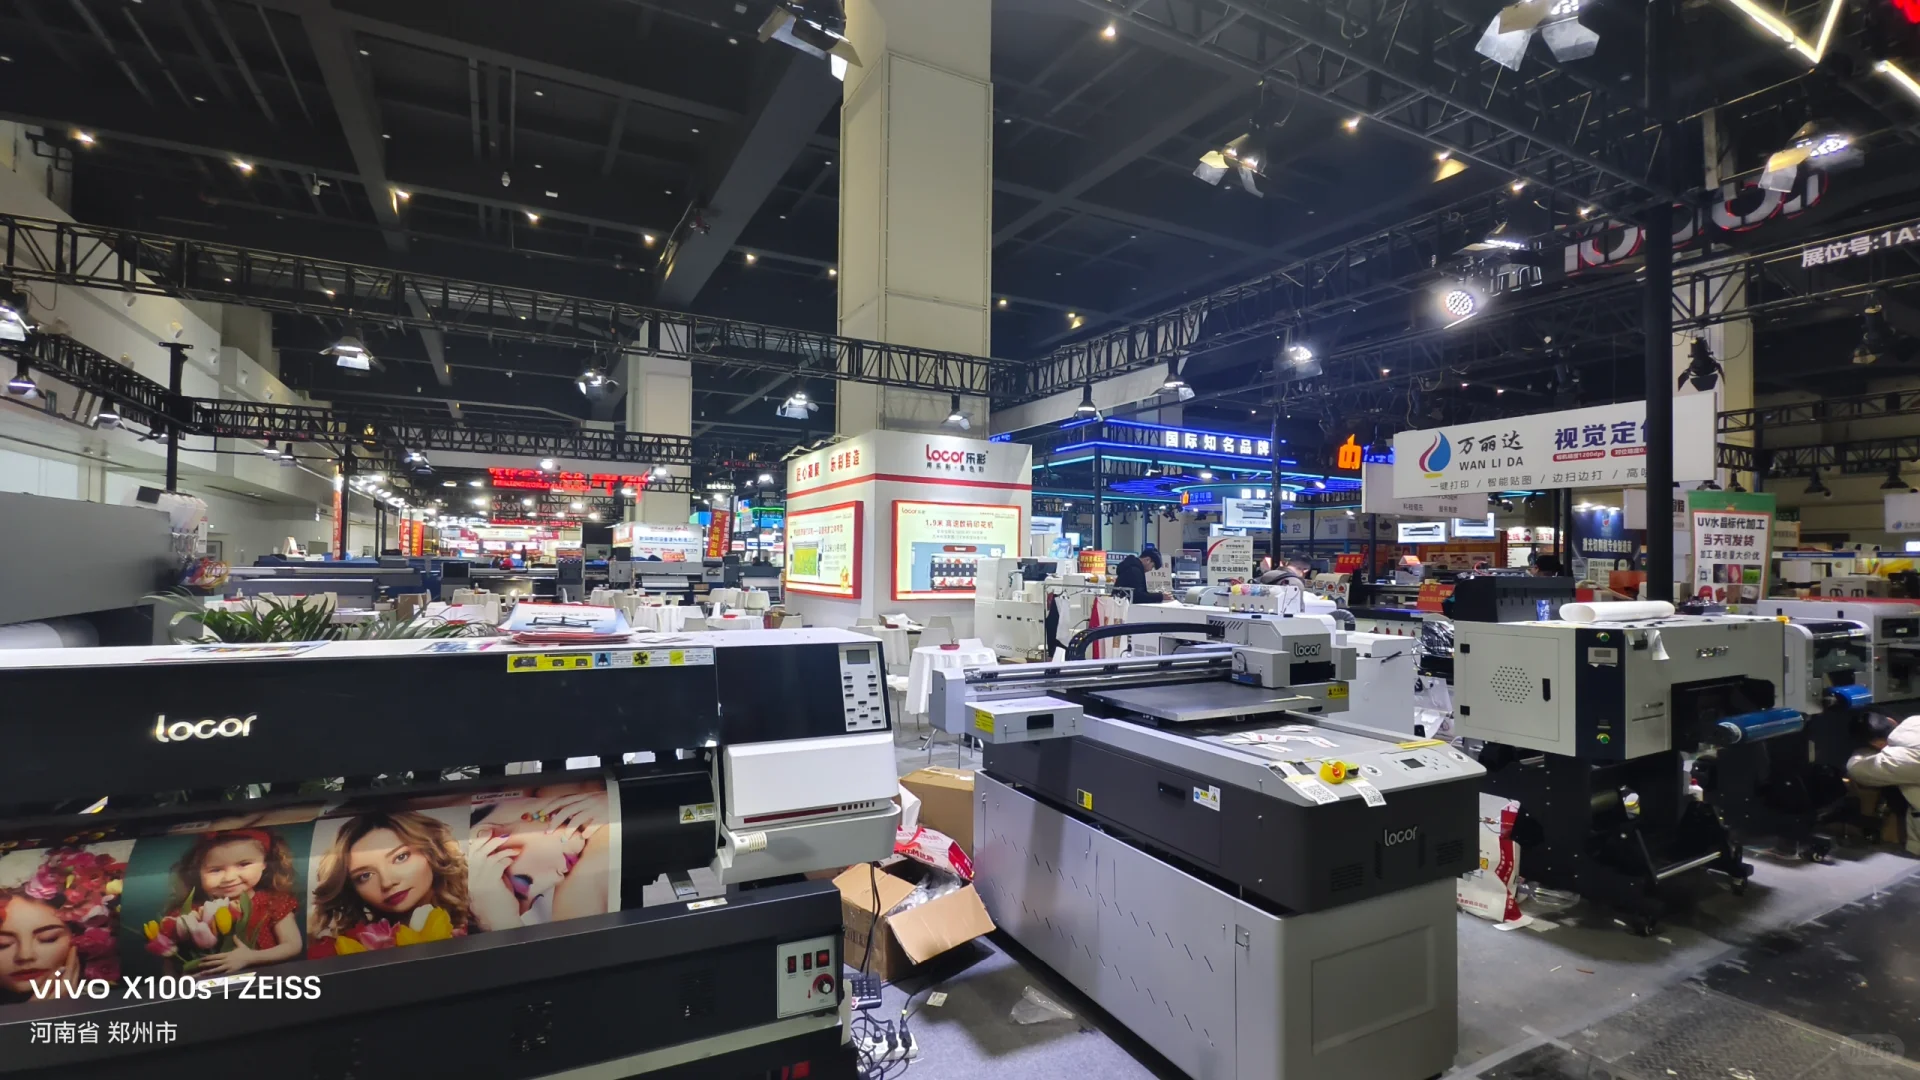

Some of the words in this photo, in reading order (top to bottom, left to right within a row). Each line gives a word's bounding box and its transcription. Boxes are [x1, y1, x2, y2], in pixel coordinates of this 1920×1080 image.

[1801, 224, 1920, 268] 展位号:1A
[1165, 430, 1270, 456] 国际知名品牌
[1457, 430, 1524, 455] 万丽达
[830, 450, 860, 472] 乐彩智造
[966, 452, 986, 465] 乐彩
[1459, 460, 1486, 471] WAN
[1491, 459, 1501, 468] LI
[1507, 456, 1524, 467] DA
[1430, 479, 1469, 491] 一键打印
[1487, 475, 1532, 488] 智能贴图
[1552, 470, 1603, 484] 边扫边打
[925, 519, 944, 527] 1.9米
[1697, 516, 1765, 530] UV水晶标代加工
[1703, 533, 1755, 547] 当天可发货
